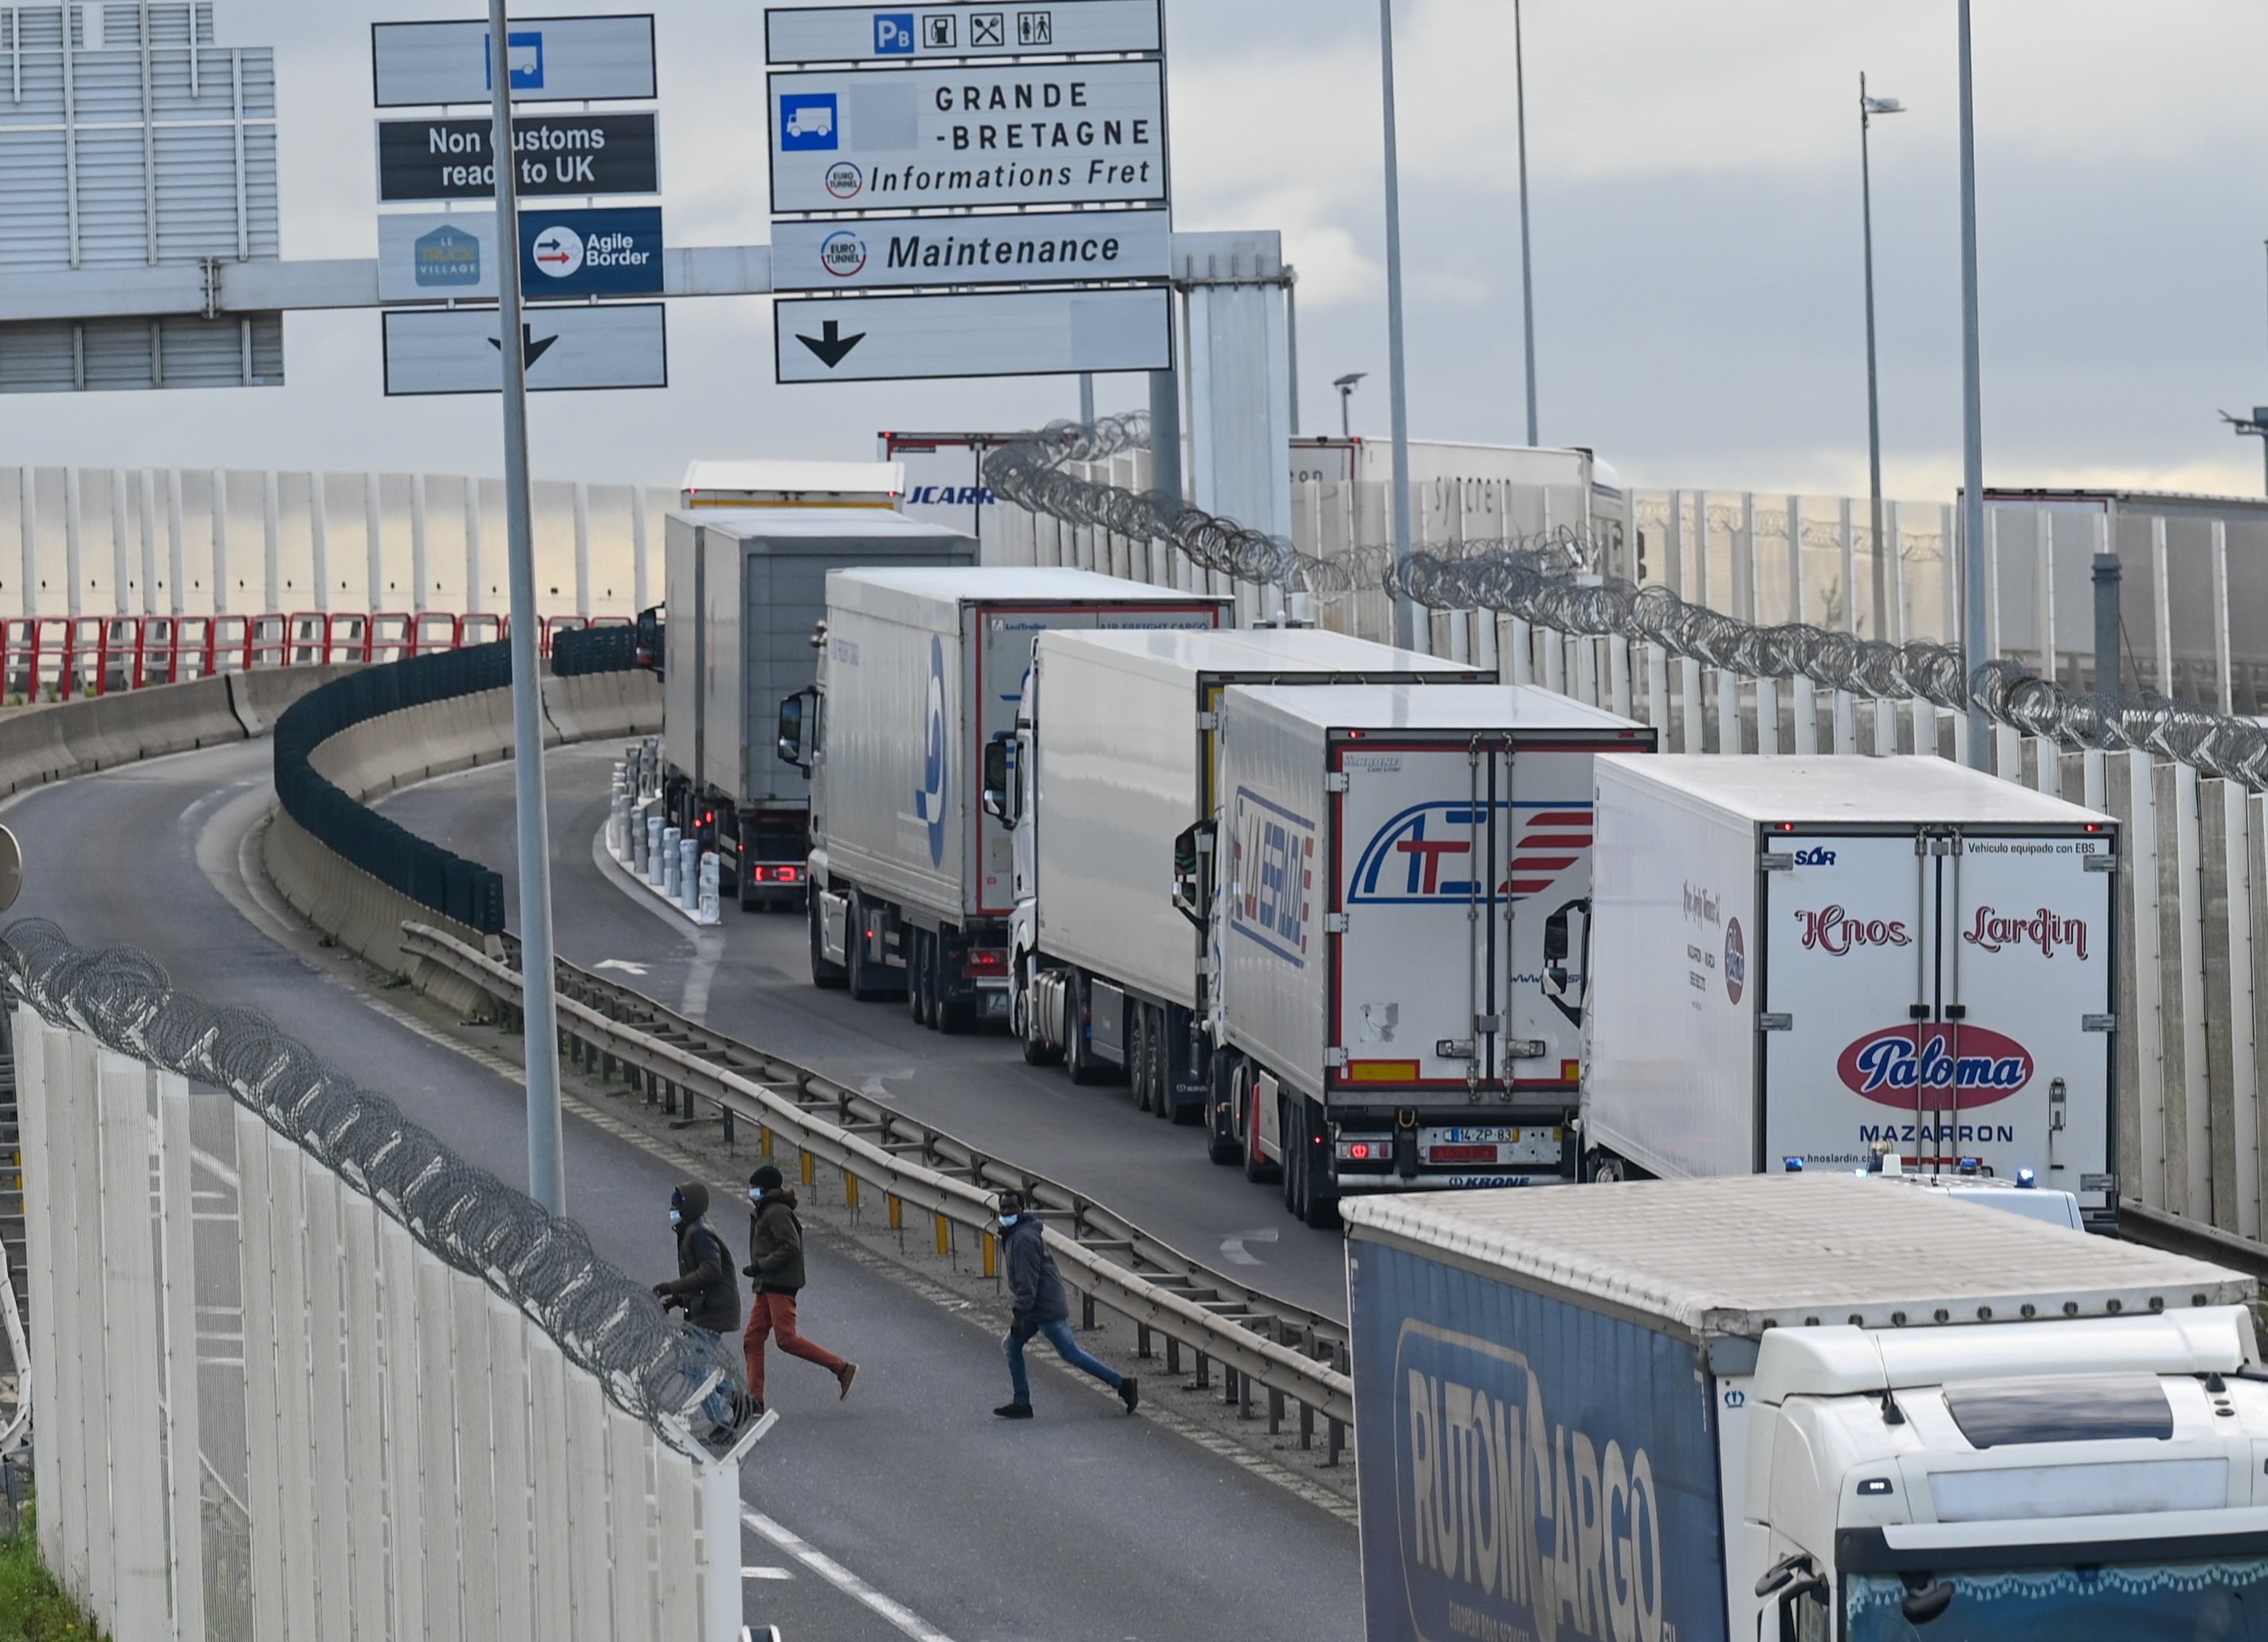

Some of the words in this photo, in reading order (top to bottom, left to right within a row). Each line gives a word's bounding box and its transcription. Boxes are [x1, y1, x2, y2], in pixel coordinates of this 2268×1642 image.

[935, 81, 1088, 112] GRANDE
[429, 127, 481, 154] Non
[489, 125, 606, 152] ustoms
[442, 164, 497, 186] read
[521, 159, 547, 184] to
[555, 155, 595, 183] UK
[833, 171, 854, 180] EURO
[870, 162, 1073, 192] Informations
[1087, 159, 1151, 186] Fret
[830, 180, 857, 189] TUNNEL
[586, 233, 634, 251] Agile
[830, 243, 856, 254] EURO
[586, 249, 650, 267] Border
[826, 253, 861, 265] TUNNEL
[886, 235, 1120, 268] Maintenance
[420, 264, 477, 275] VILLAGE
[2011, 842, 2054, 856] equipado
[2055, 844, 2073, 854] con
[2075, 842, 2095, 854] EBS
[1854, 1034, 2027, 1094] Paloma
[1465, 1176, 1531, 1187] KRONE
